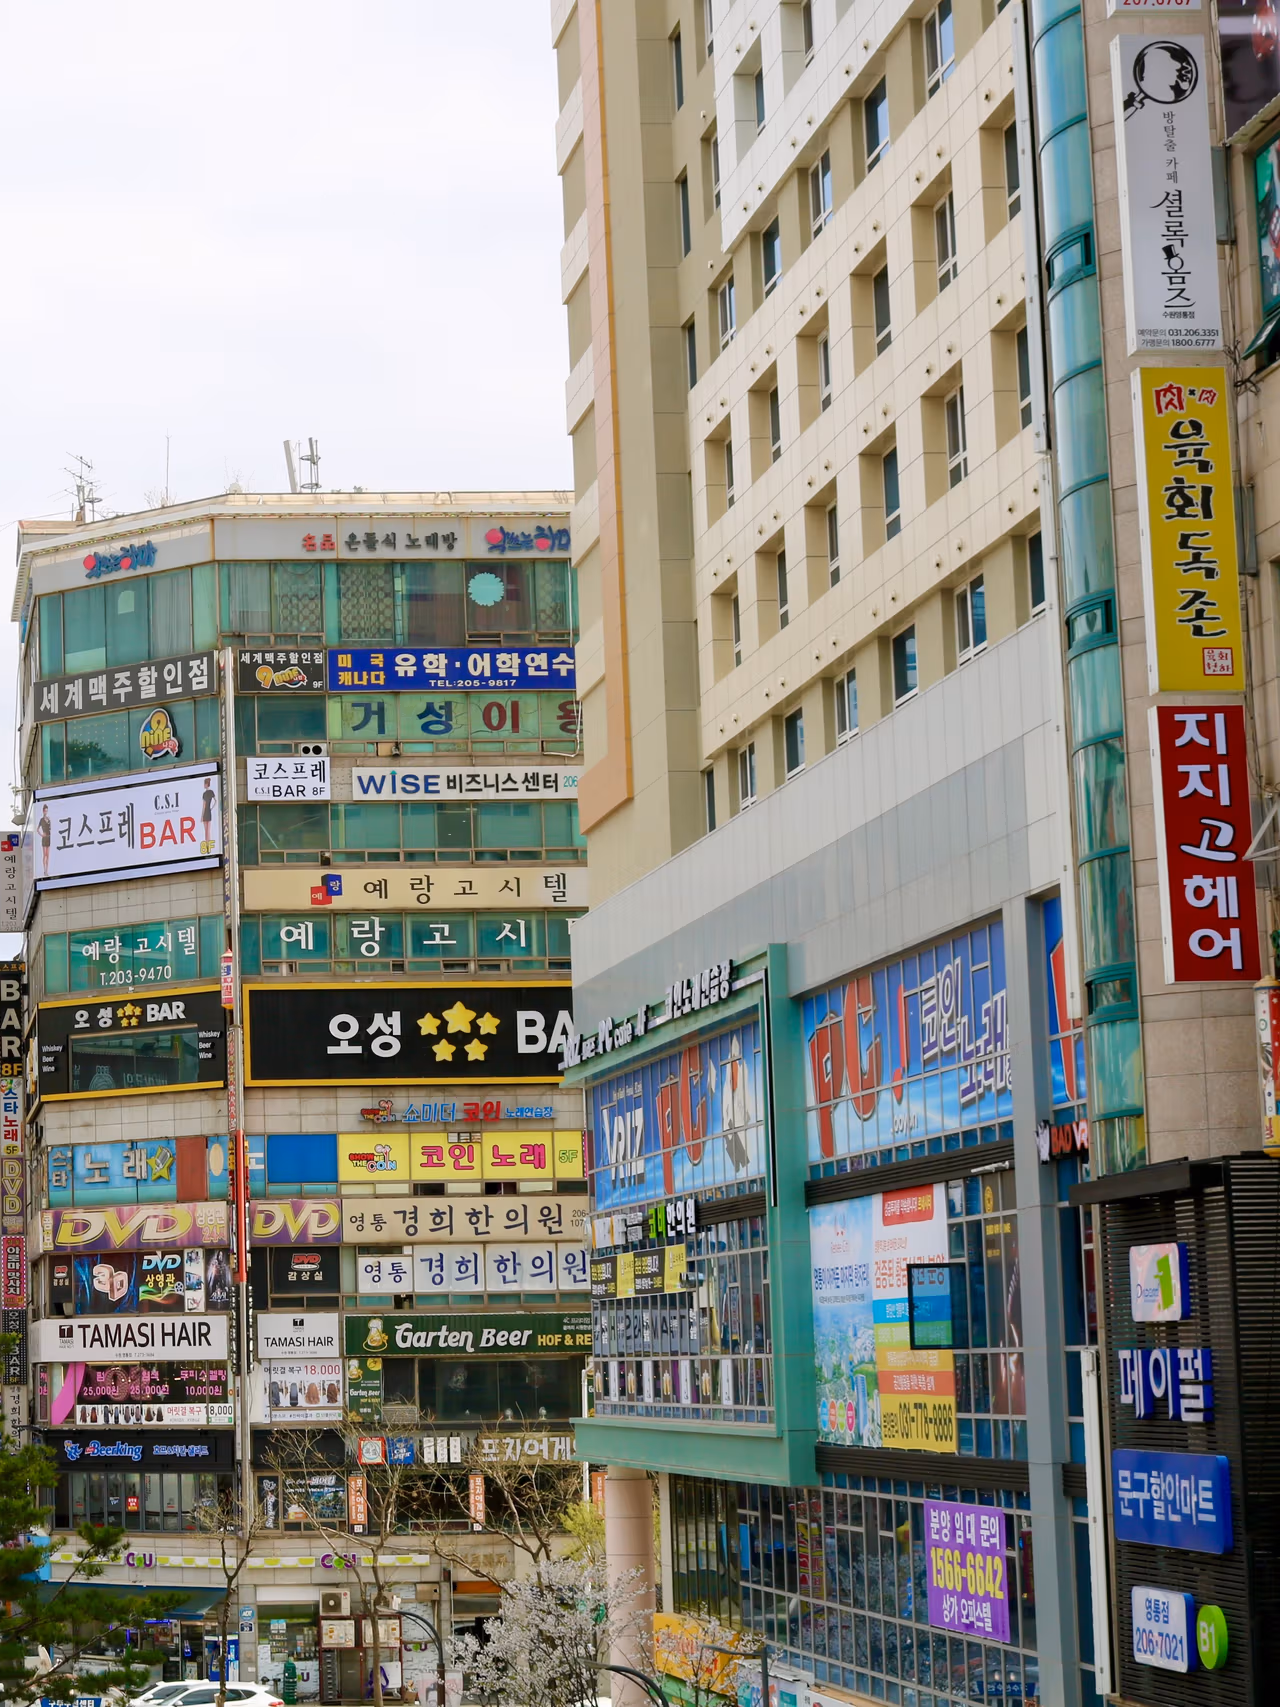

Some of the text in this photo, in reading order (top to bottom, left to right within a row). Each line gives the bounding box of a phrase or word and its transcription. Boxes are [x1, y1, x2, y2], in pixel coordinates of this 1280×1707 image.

[302, 533, 336, 551] 名品
[405, 532, 458, 551] 노래방
[240, 652, 324, 664] 세계맥주할인점
[39, 656, 209, 714] 세계맥주할인점
[338, 671, 386, 686] 캐나다
[429, 679, 517, 688] TEL:205-9817
[253, 760, 326, 783] 코스프레
[357, 770, 559, 795] WISE 비즈니스센터
[271, 784, 326, 798] BAR 8F
[56, 802, 216, 854] 코스프레 BAR 8F
[82, 926, 196, 964] 예랑 고시텔
[0, 978, 22, 1058] BAR
[75, 1001, 186, 1029] 오성 BAR
[198, 1030, 220, 1038] Whiskey
[198, 1041, 211, 1049] Beer
[327, 1010, 402, 1058] 오성
[42, 1045, 63, 1053] Whiskey
[42, 1055, 54, 1063] Beer
[198, 1052, 212, 1060] Wine
[1, 1063, 22, 1077] 8F
[808, 976, 882, 1158] PC
[402, 1101, 553, 1123] 쇼미더 코인 노래연습장
[6, 1146, 18, 1155] 5F
[1051, 1123, 1071, 1153] BAD
[84, 1149, 148, 1184] 노래
[420, 1143, 578, 1171] 코인 노래 5F
[2, 1159, 23, 1215] DVD
[55, 1207, 193, 1249] DVD
[252, 1201, 342, 1242] DVD
[350, 1212, 387, 1233] 영통
[393, 1203, 564, 1237] 경희한의원
[142, 1254, 182, 1271] DVD
[287, 1271, 323, 1281] 감상실
[364, 1262, 407, 1284] 영통
[420, 1249, 588, 1286] 경희한의원
[145, 1273, 175, 1287] 상영관
[78, 1321, 212, 1348] TAMASI HAIR
[264, 1336, 334, 1347] TAMASI HAIR
[394, 1323, 573, 1353] Garten Beer HOF &
[304, 1365, 340, 1375] 18.000
[1118, 1470, 1217, 1525] 문구할인마트
[930, 1509, 1001, 1549] 분양 임대 문의
[930, 1547, 1004, 1599] 1566-6642
[942, 1594, 992, 1632] 상가 오피스텔
[1145, 1597, 1170, 1625] 영통점
[1200, 1621, 1217, 1655] B1
